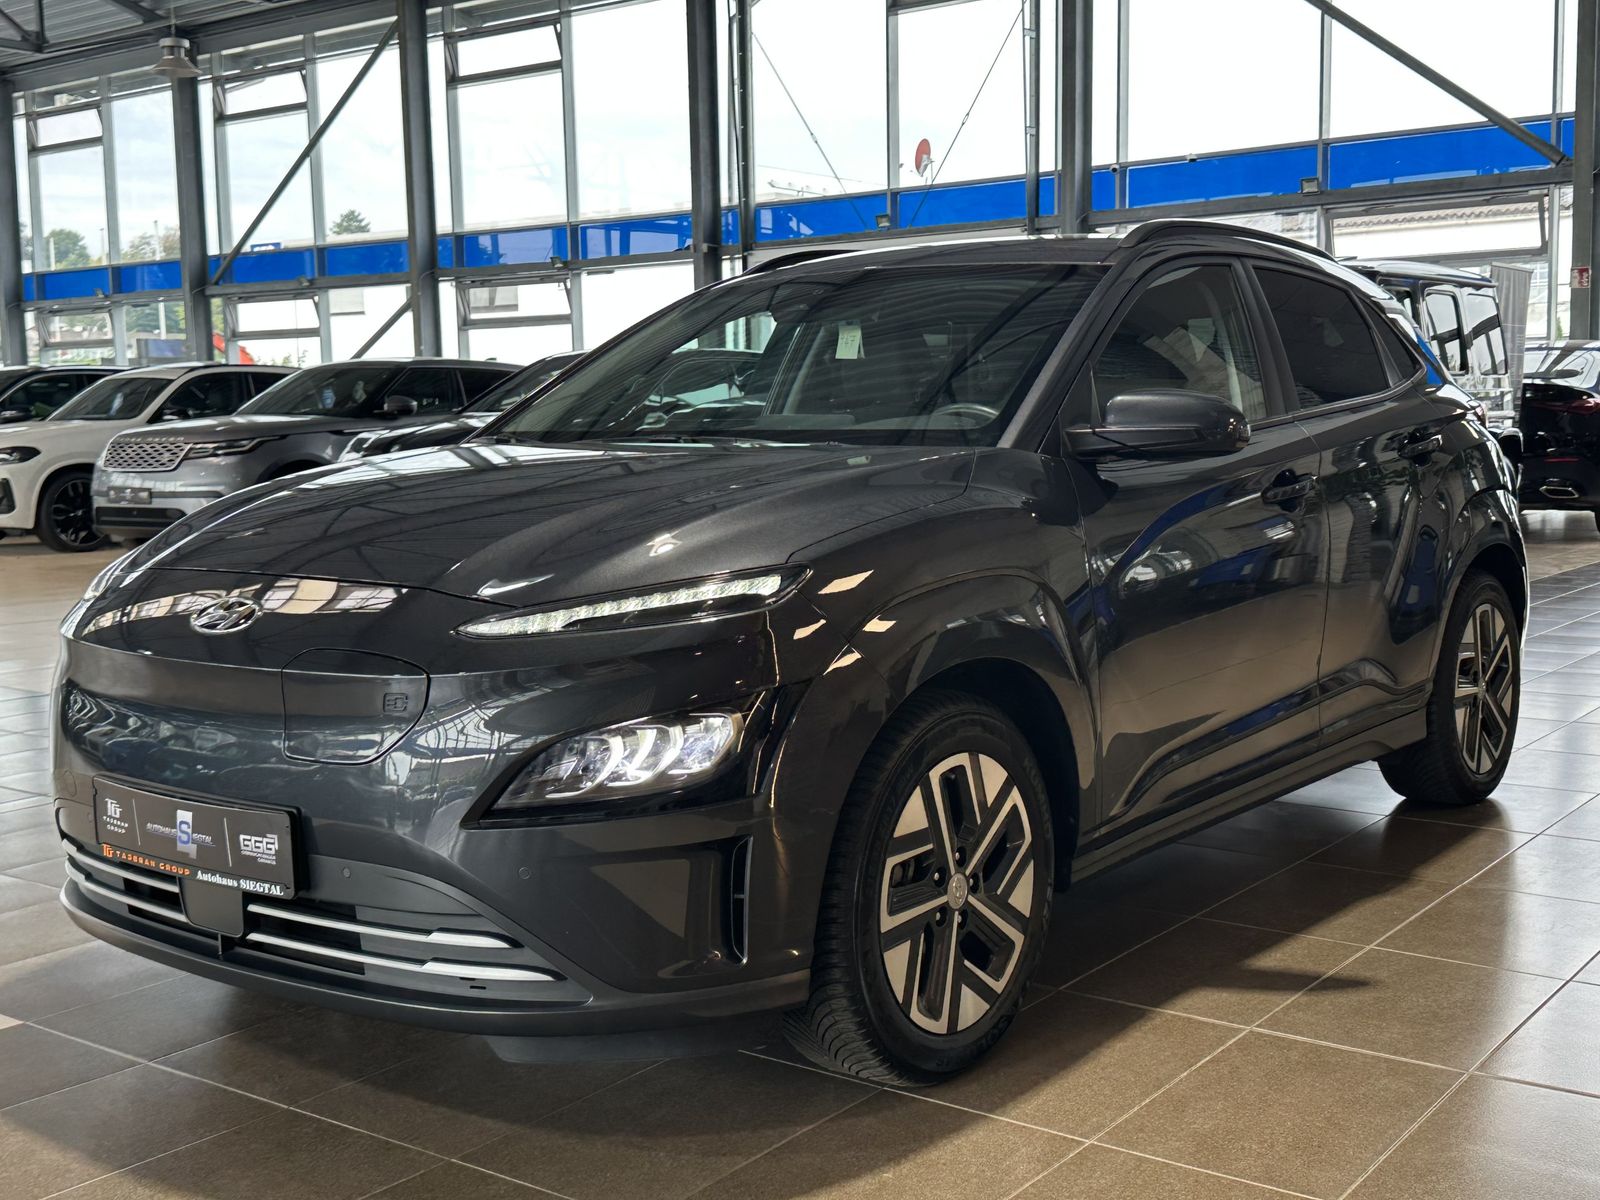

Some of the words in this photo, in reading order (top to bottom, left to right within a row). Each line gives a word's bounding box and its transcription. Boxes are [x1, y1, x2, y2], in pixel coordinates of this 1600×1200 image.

[159, 862, 191, 876] GROUP
[196, 870, 238, 887] Autohaus
[240, 879, 284, 896] SIEGTAL
